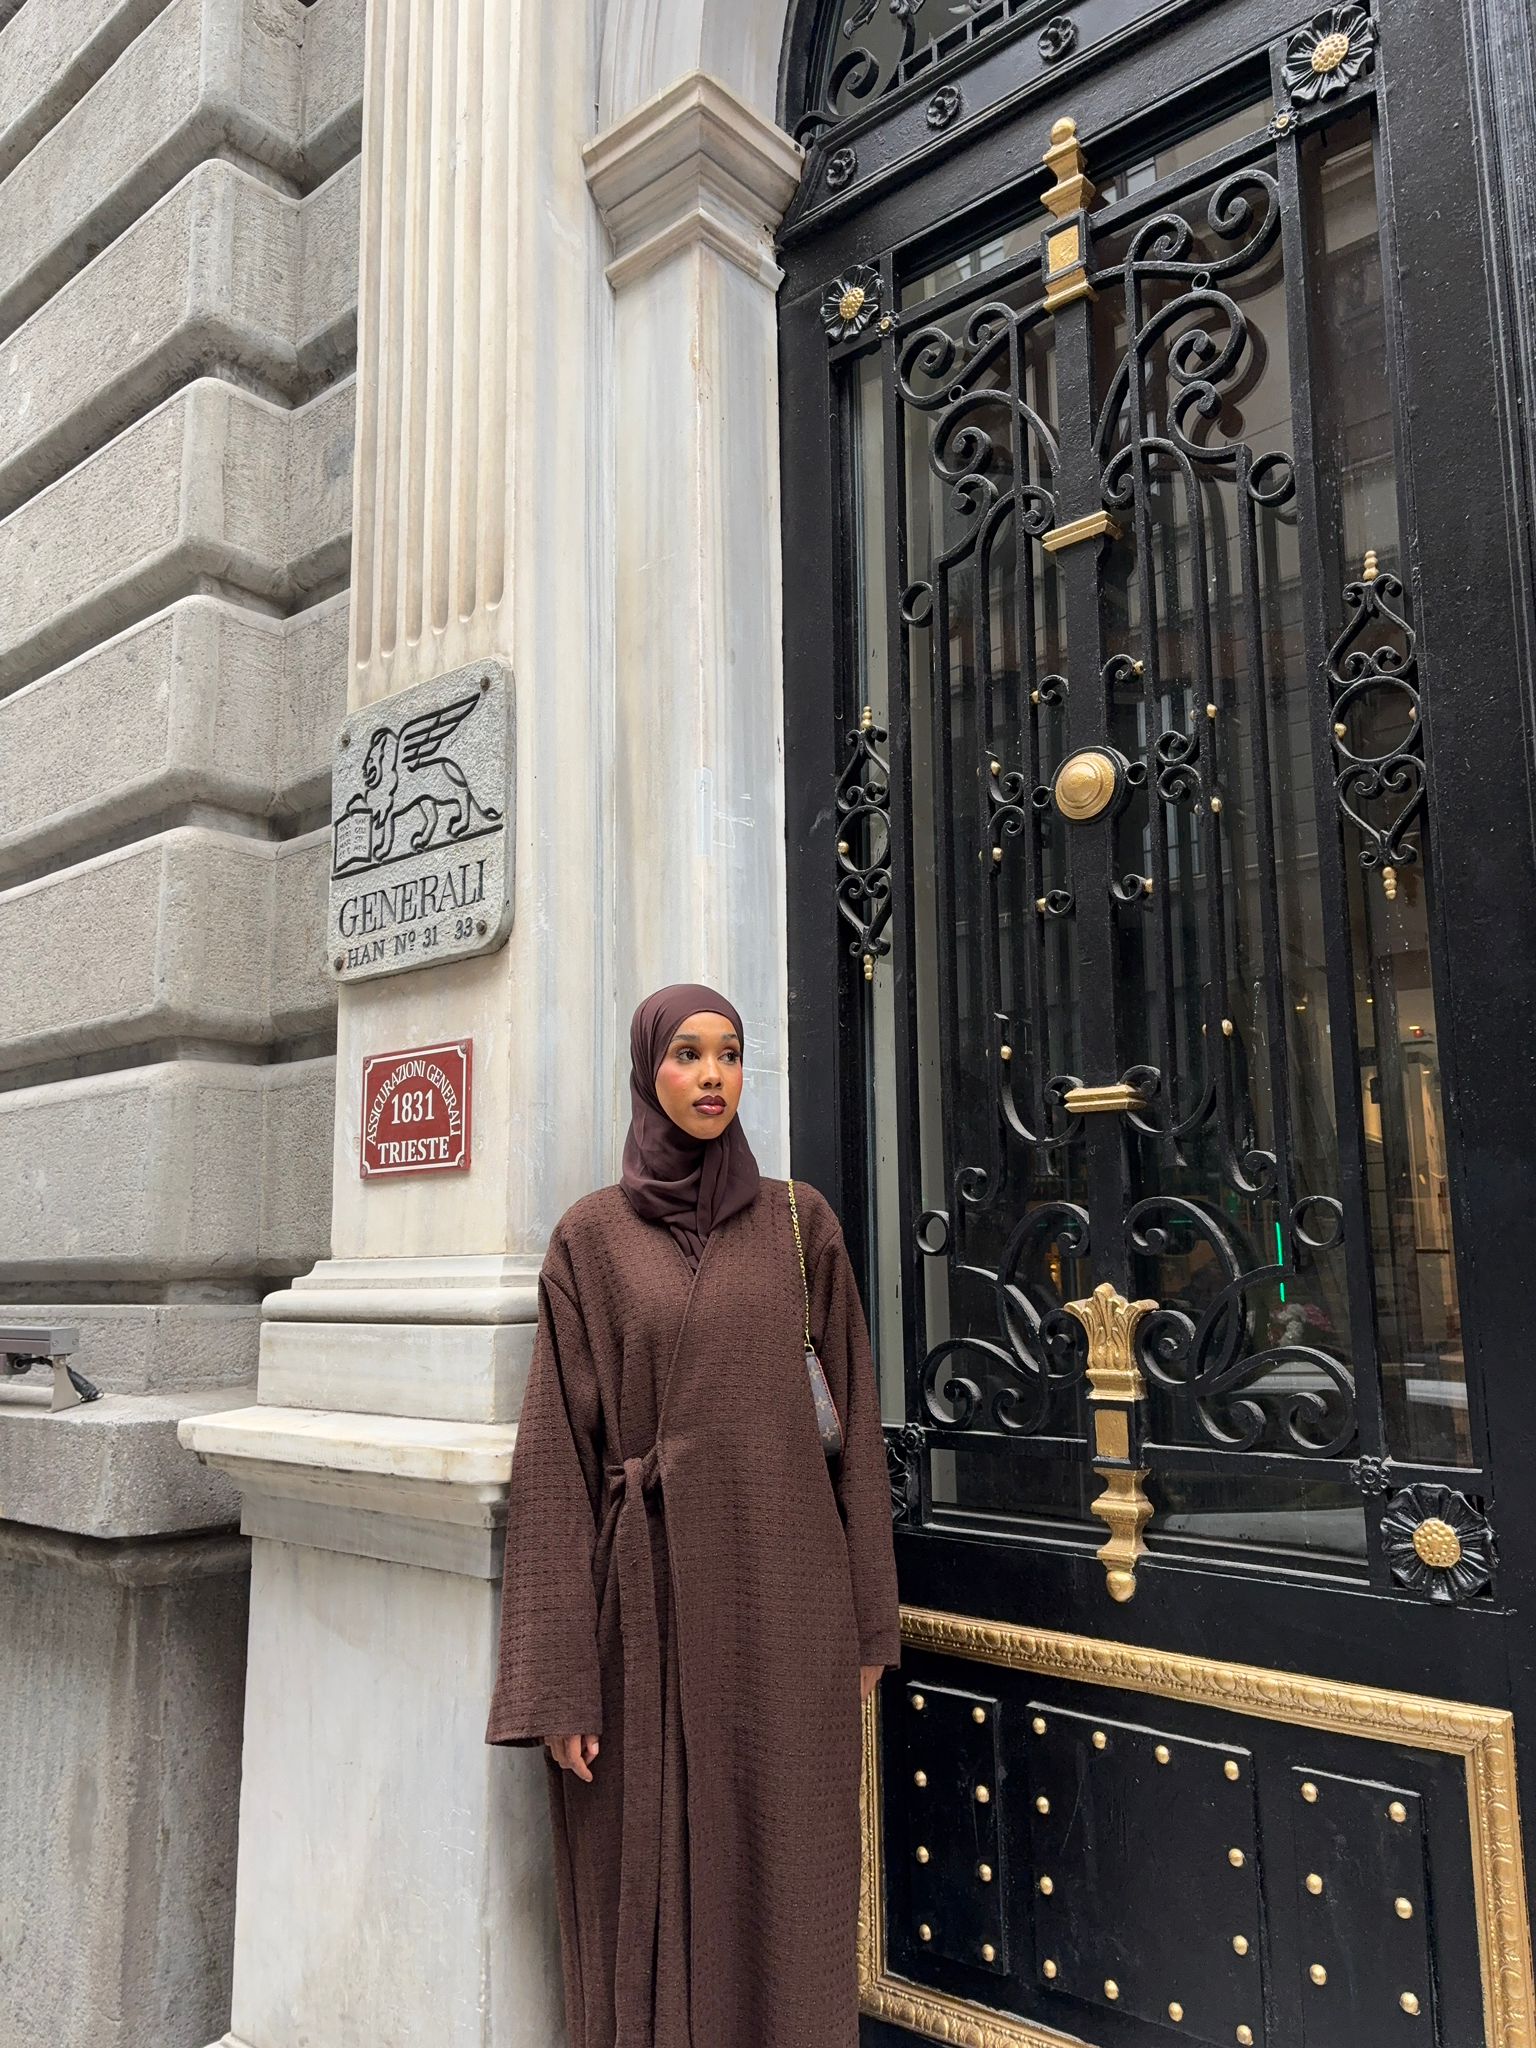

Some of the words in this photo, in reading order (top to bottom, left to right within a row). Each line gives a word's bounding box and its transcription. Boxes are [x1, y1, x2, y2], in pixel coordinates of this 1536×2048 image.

[339, 859, 486, 937] GENERALI
[346, 939, 385, 969] HAN
[423, 925, 439, 948] 31
[455, 917, 474, 940] 33
[366, 1060, 426, 1146] ASSICURAZIONI
[426, 1064, 462, 1137] GENERALI
[391, 1089, 435, 1125] 1831
[377, 1136, 450, 1165] TRIESTE
